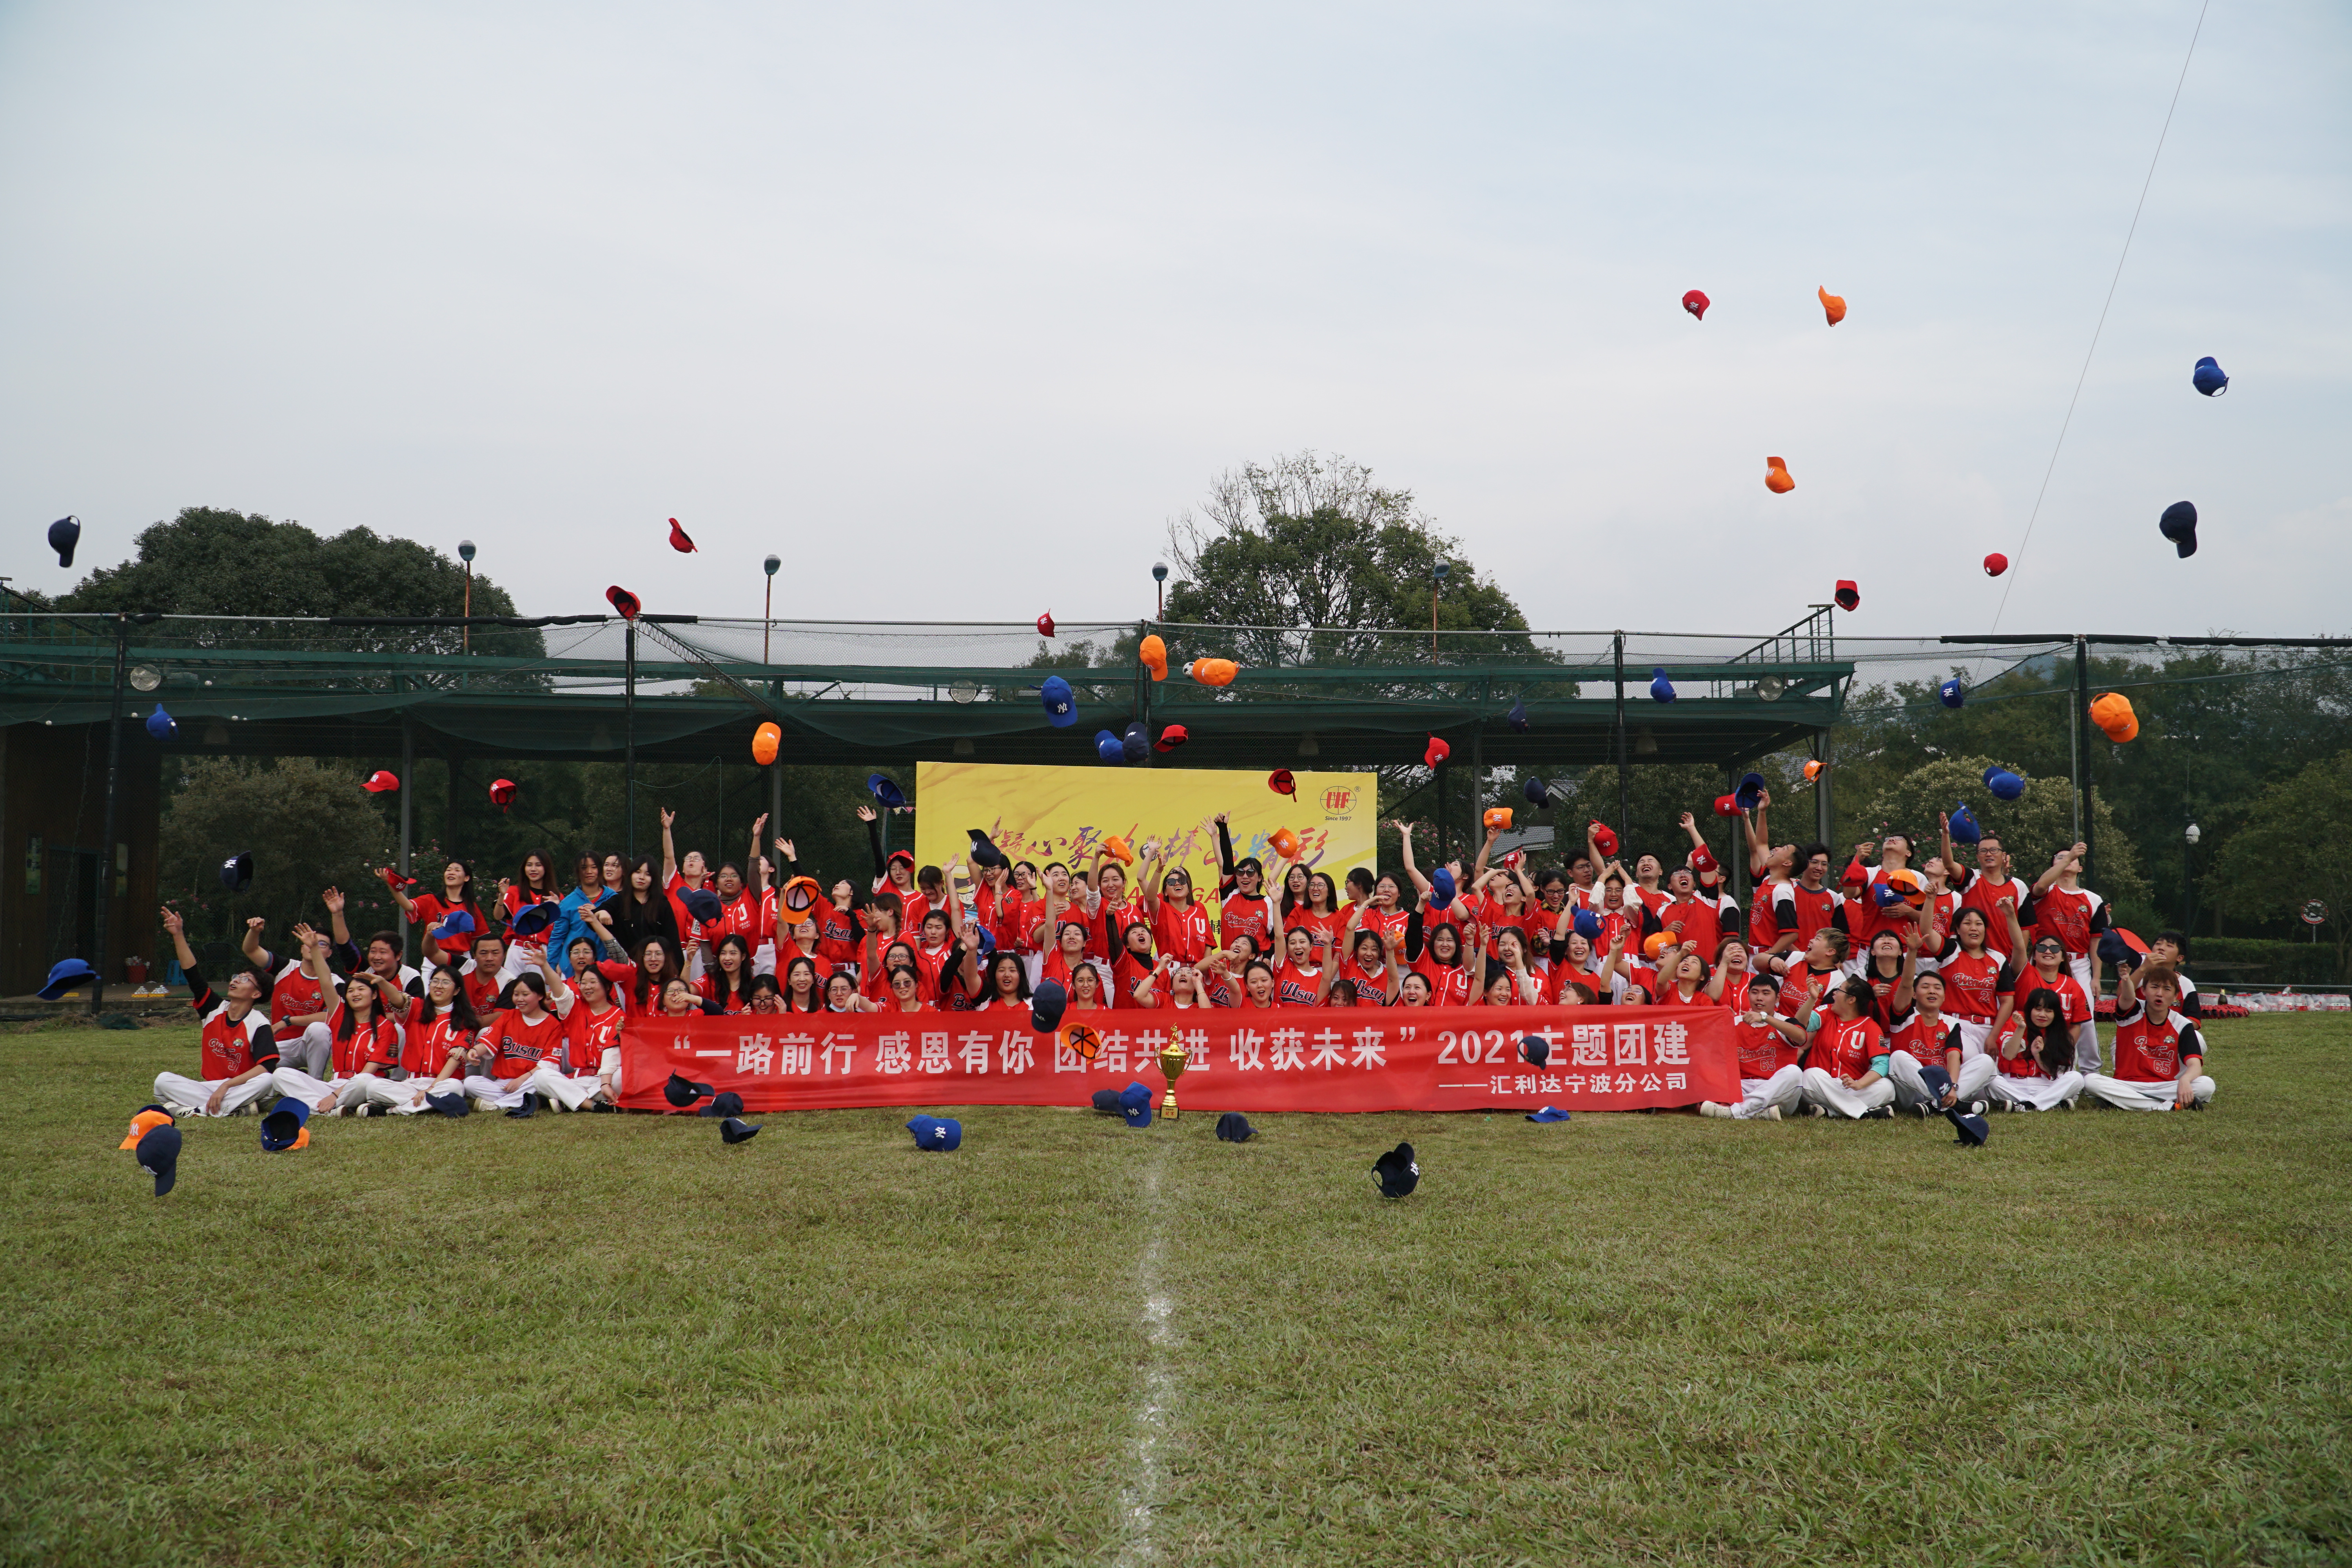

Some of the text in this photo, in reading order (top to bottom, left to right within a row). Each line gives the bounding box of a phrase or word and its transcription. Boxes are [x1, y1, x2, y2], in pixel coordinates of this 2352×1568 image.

[1057, 702, 1067, 713] NY
[738, 903, 748, 921] U
[1194, 918, 1206, 933] U
[1457, 974, 1468, 989] U
[1281, 979, 1316, 1002] Ulsa
[2060, 993, 2073, 1011] U
[502, 1036, 544, 1059] Busan
[1850, 1031, 1865, 1050] U
[875, 1030, 1034, 1075] 感恩有你
[1760, 1059, 1776, 1072] 65
[2153, 1060, 2171, 1075] 65
[935, 1127, 946, 1138] NY
